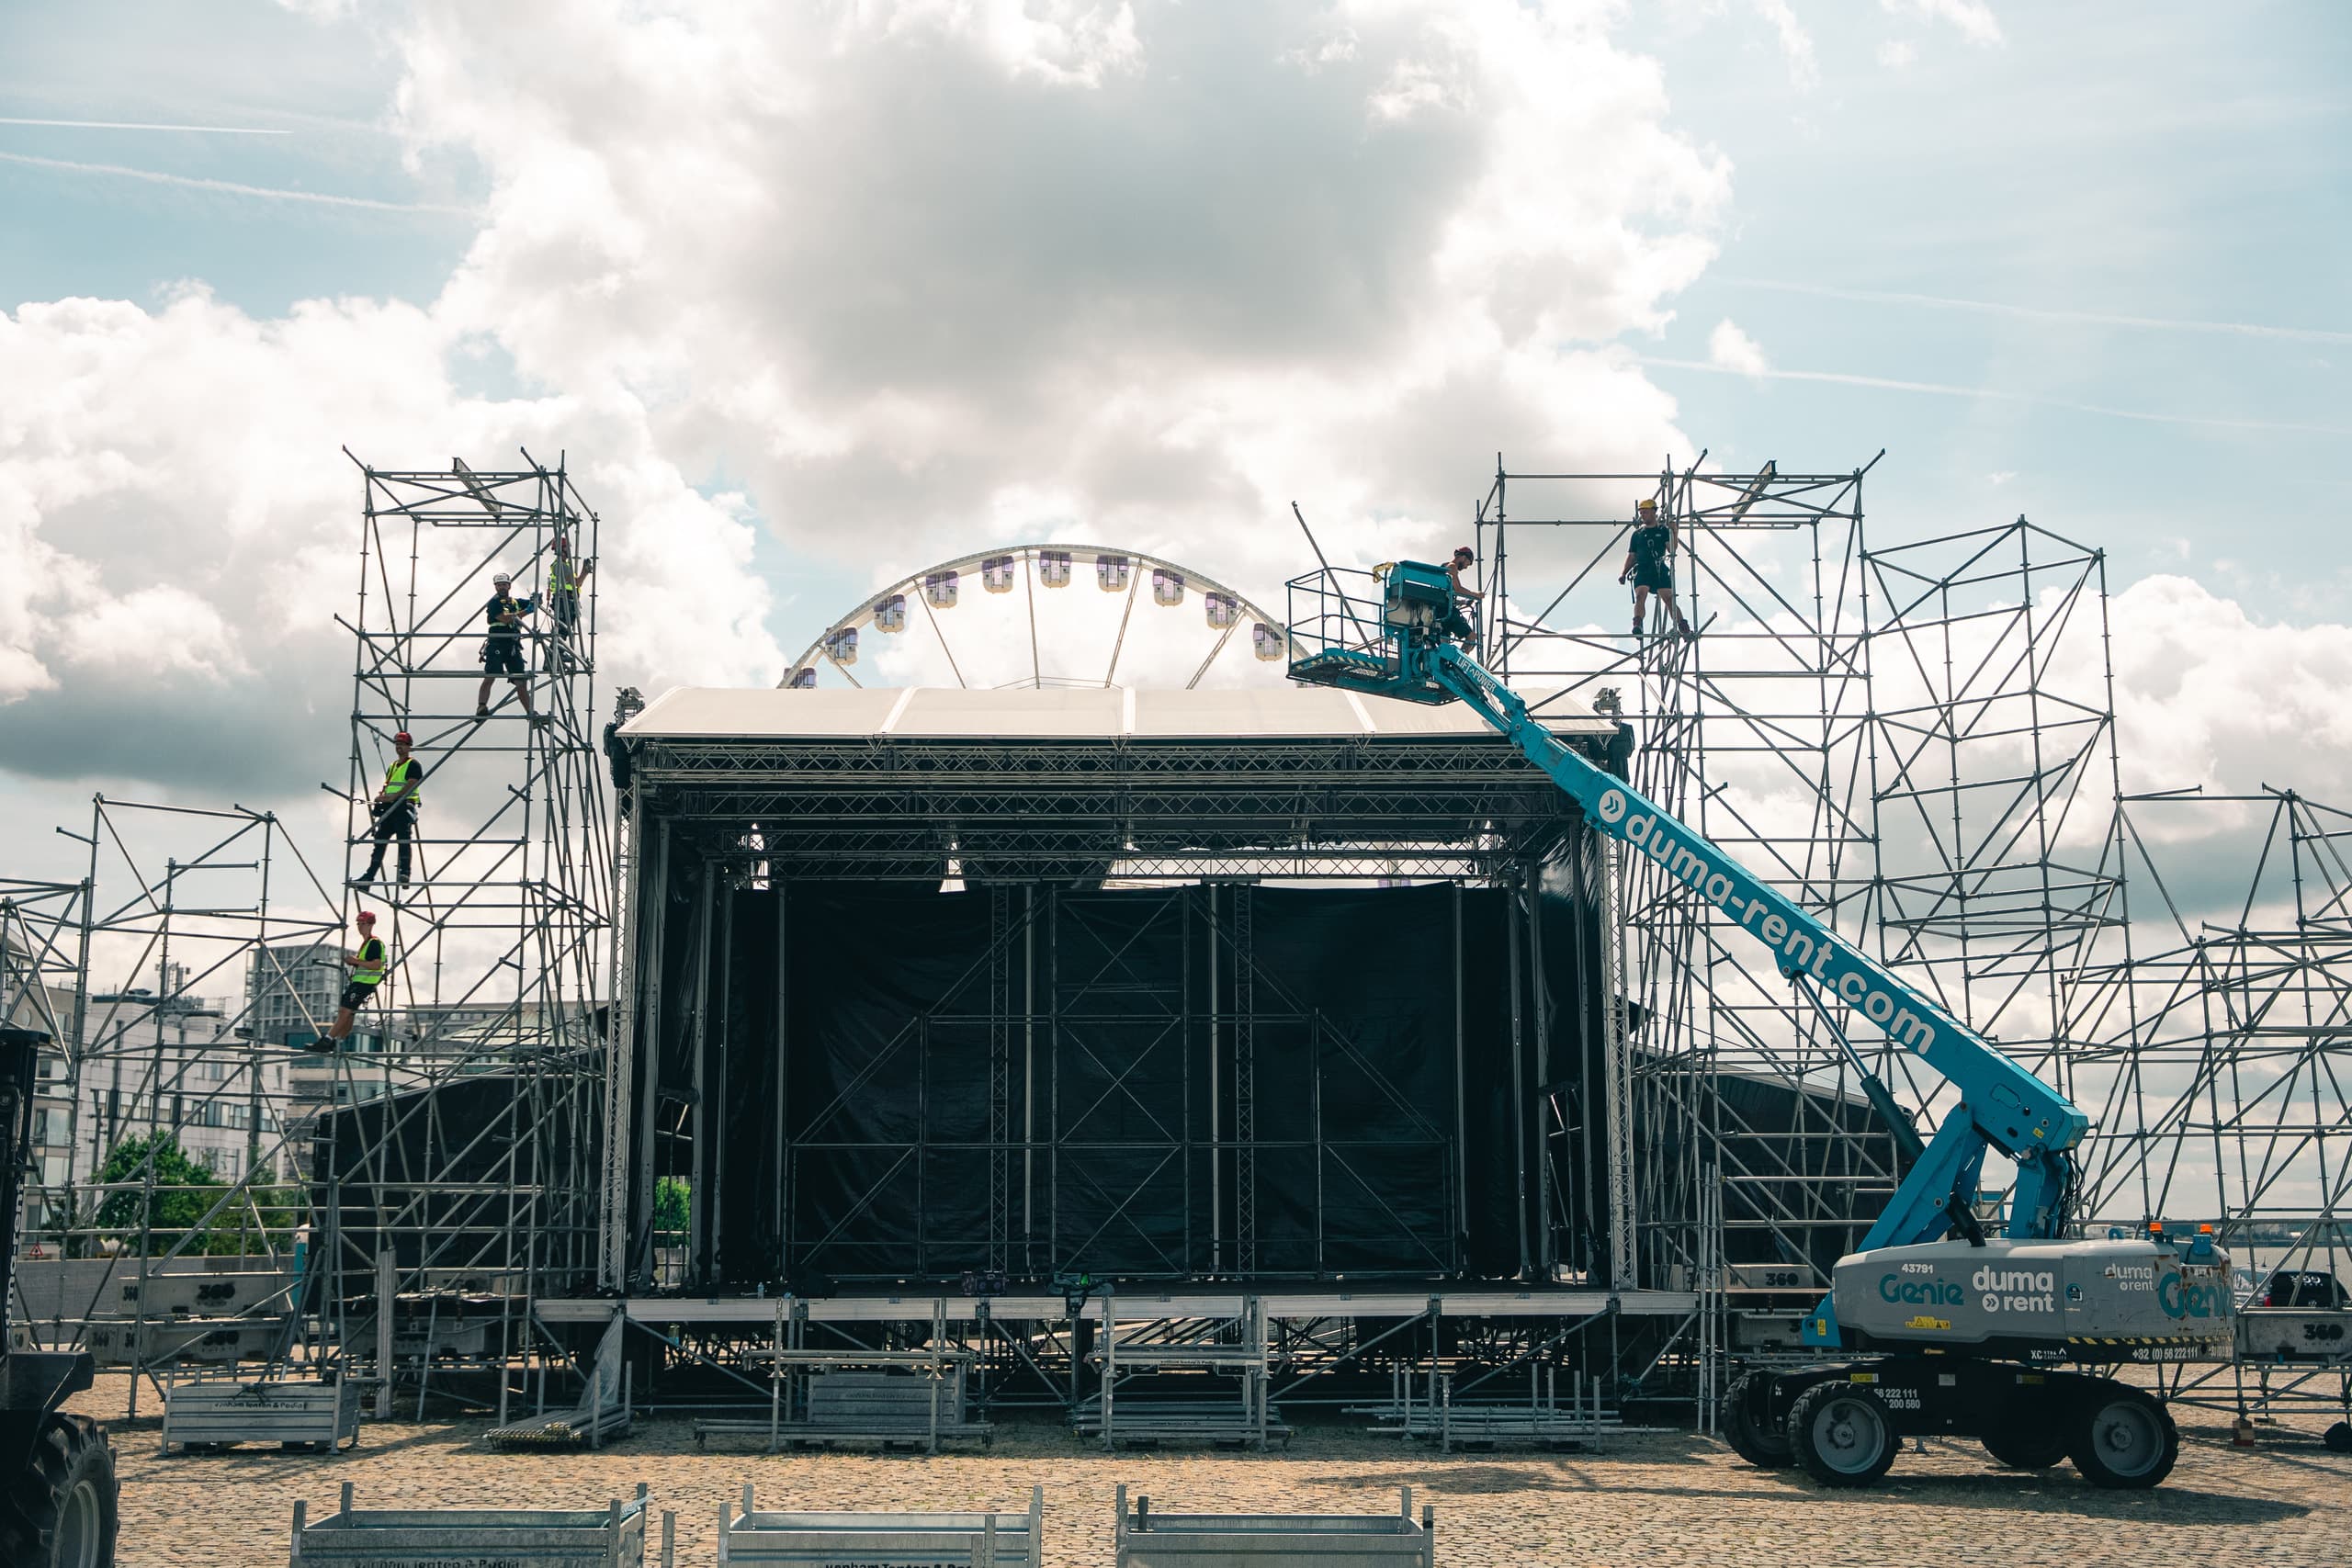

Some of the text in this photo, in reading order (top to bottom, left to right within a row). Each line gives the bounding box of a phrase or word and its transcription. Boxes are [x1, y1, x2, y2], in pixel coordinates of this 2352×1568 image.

[1456, 657, 1497, 693] LIFT POWER
[1625, 813, 1936, 1055] duma-rent.com
[1902, 1263, 1934, 1274] 43791
[2104, 1263, 2153, 1280] duma
[1765, 1272, 1799, 1286] 360
[1973, 1264, 2054, 1292] duma
[1879, 1273, 1964, 1305] Genie
[2129, 1280, 2154, 1292] rent
[2004, 1293, 2054, 1313] rent
[2303, 1324, 2344, 1340] 360
[2030, 1349, 2042, 1360] XC
[2132, 1348, 2149, 1360] +32
[2152, 1348, 2163, 1360] (0)
[2174, 1347, 2188, 1359] 222
[2188, 1347, 2198, 1359] 111
[1885, 1388, 1902, 1398] 222
[1902, 1388, 1917, 1398] 111
[1889, 1399, 1920, 1409] 200 580
